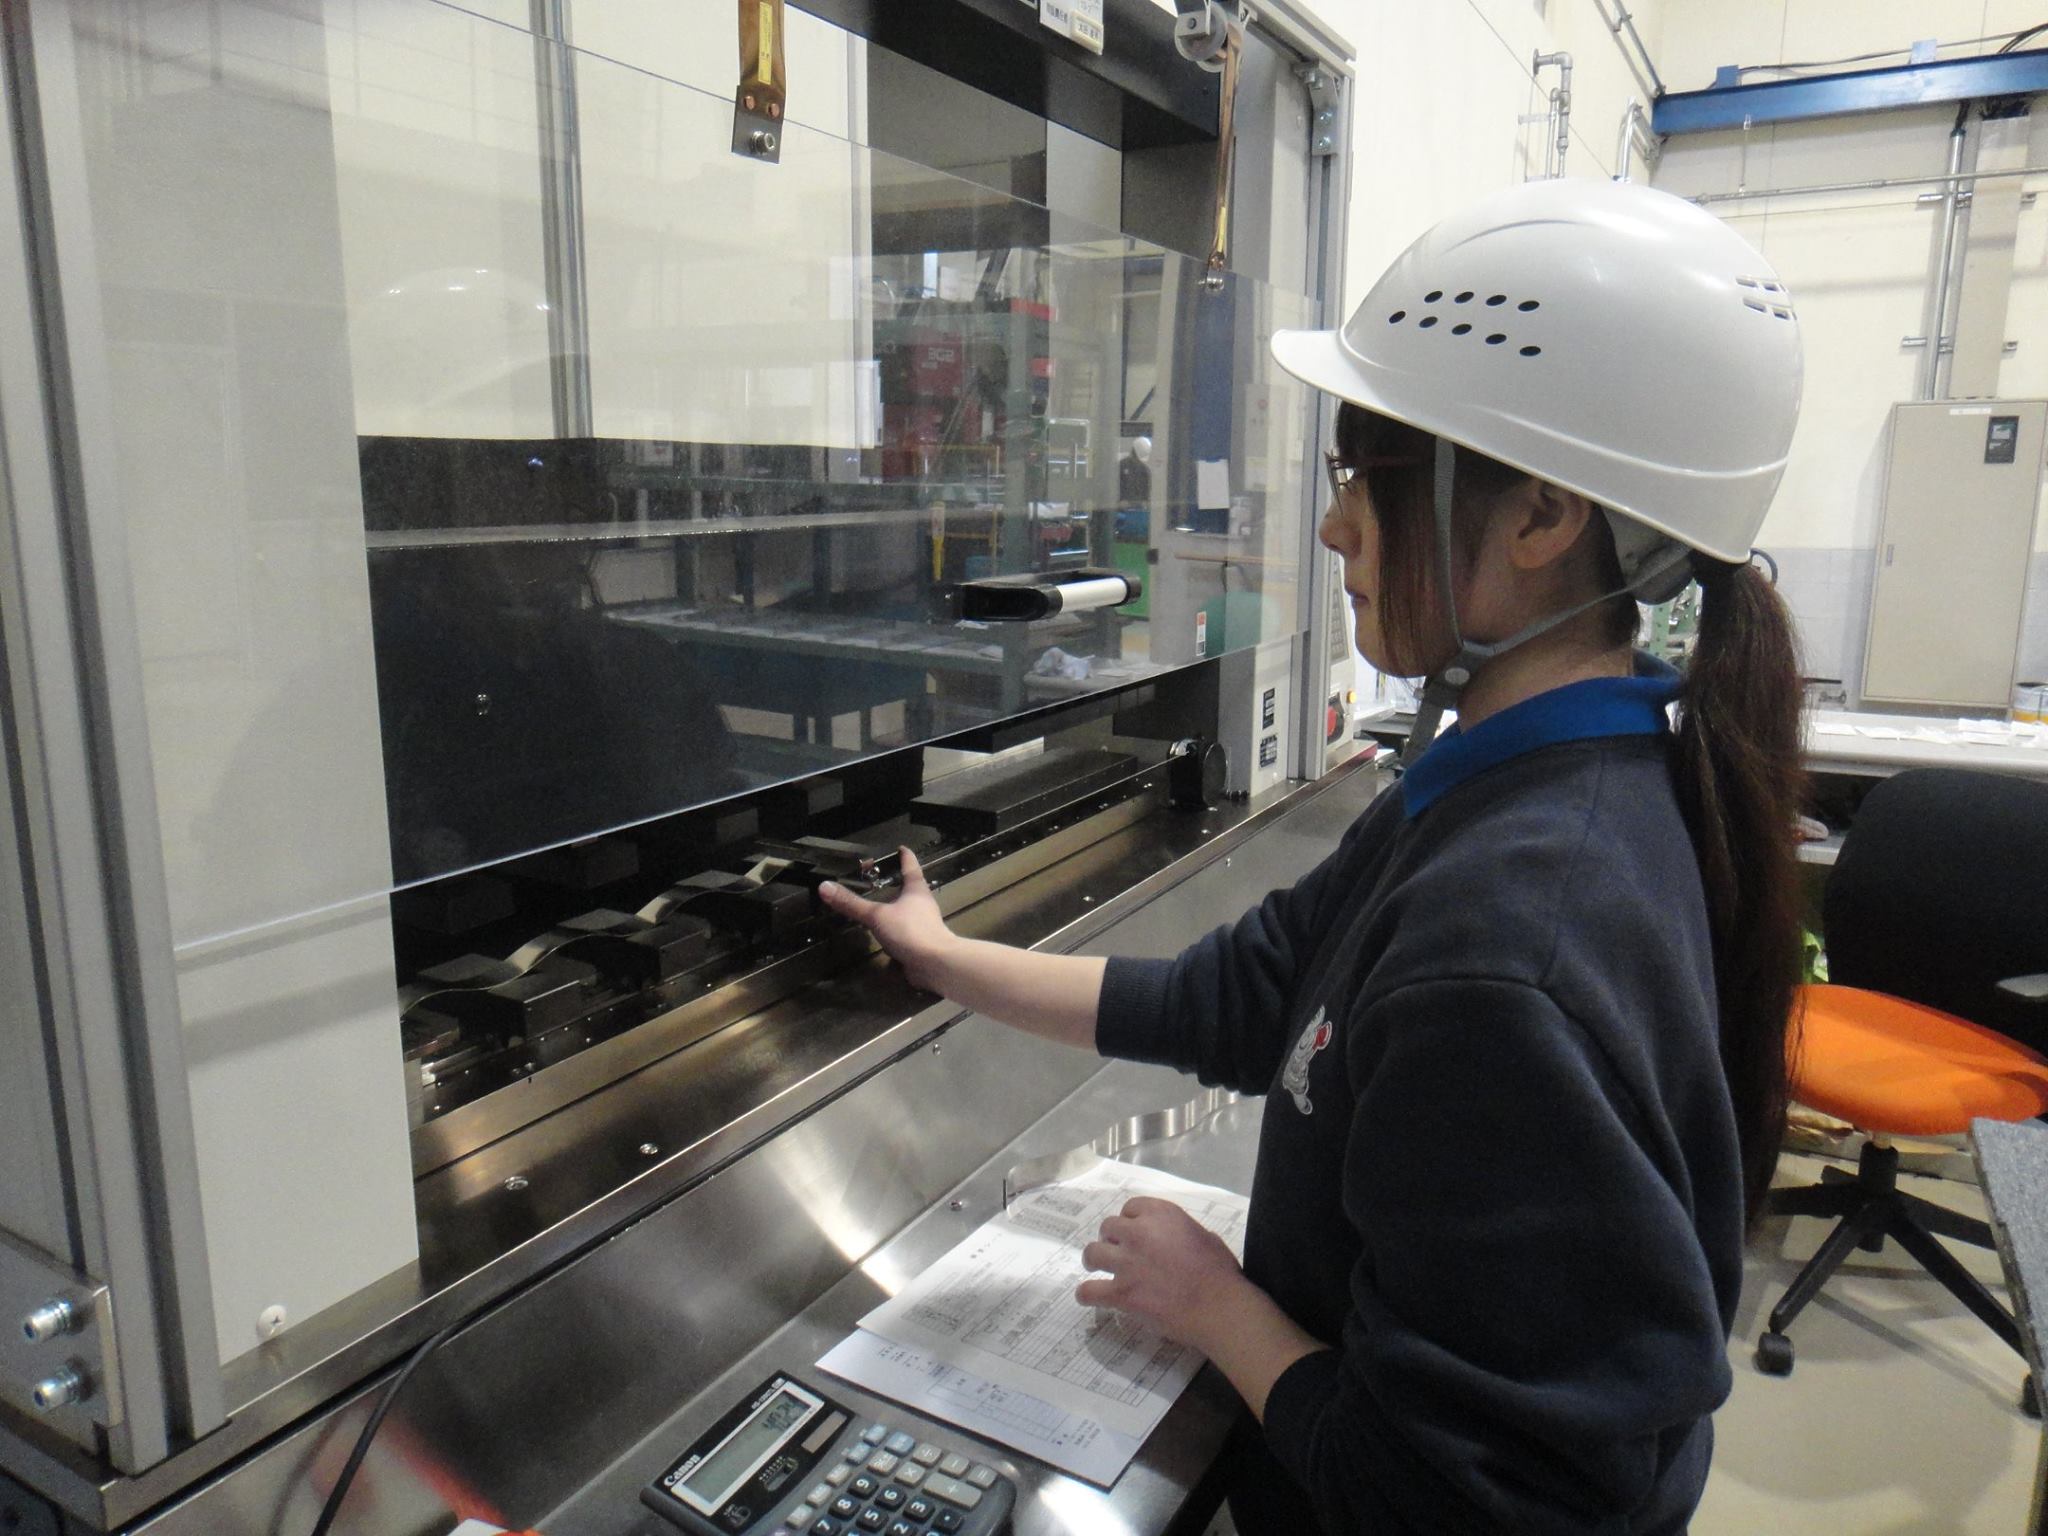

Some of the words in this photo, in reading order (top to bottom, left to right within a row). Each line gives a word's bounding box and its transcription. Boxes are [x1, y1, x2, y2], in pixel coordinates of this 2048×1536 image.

[664, 1454, 701, 1487] Canon
[856, 1478, 870, 1489] 9
[884, 1489, 898, 1500] 6
[837, 1498, 852, 1510] 8
[911, 1501, 926, 1513] 3
[864, 1509, 880, 1521] 5
[817, 1519, 831, 1531] 7
[893, 1523, 910, 1535] 2
